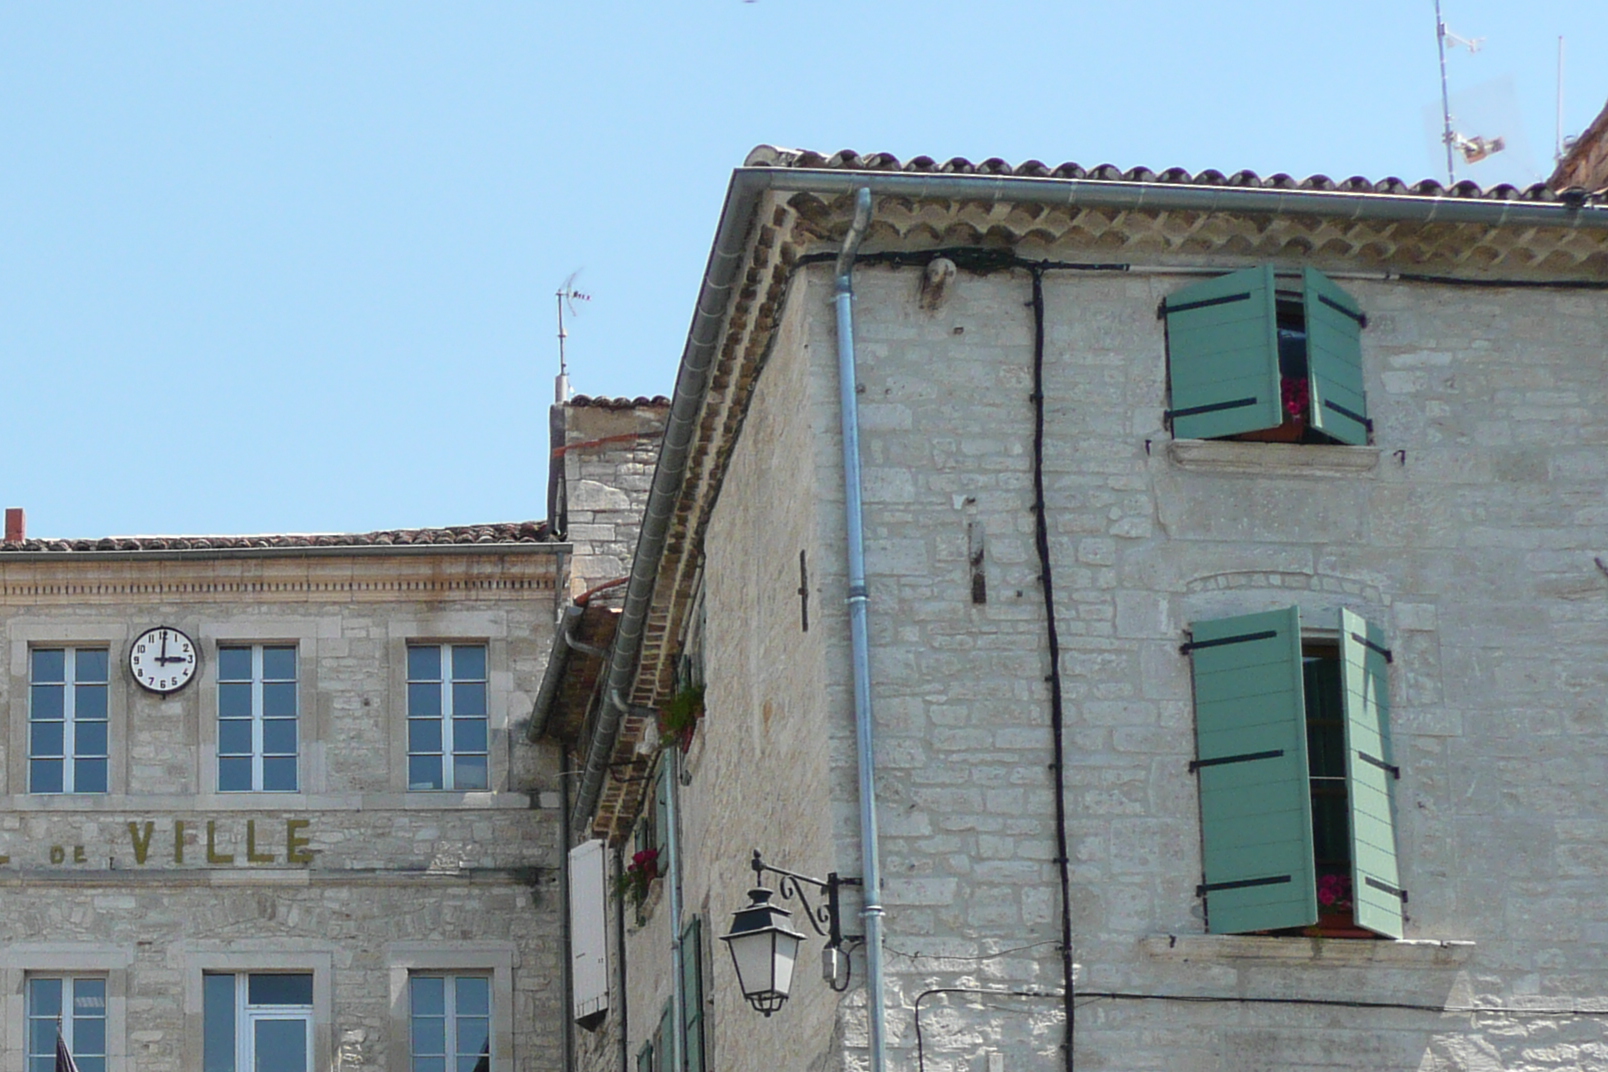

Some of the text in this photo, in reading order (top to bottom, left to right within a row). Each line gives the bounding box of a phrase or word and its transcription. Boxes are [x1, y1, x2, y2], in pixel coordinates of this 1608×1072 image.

[148, 634, 155, 643] 11
[137, 644, 146, 654] 10
[182, 643, 189, 653] 2
[133, 655, 140, 665] 9
[187, 654, 193, 664] 3
[137, 668, 144, 677] 8
[182, 668, 189, 677] 4
[148, 676, 155, 686] 7
[160, 680, 166, 689] 6
[171, 676, 178, 686] 5
[49, 845, 87, 865] DE
[128, 819, 314, 865] VILLE
